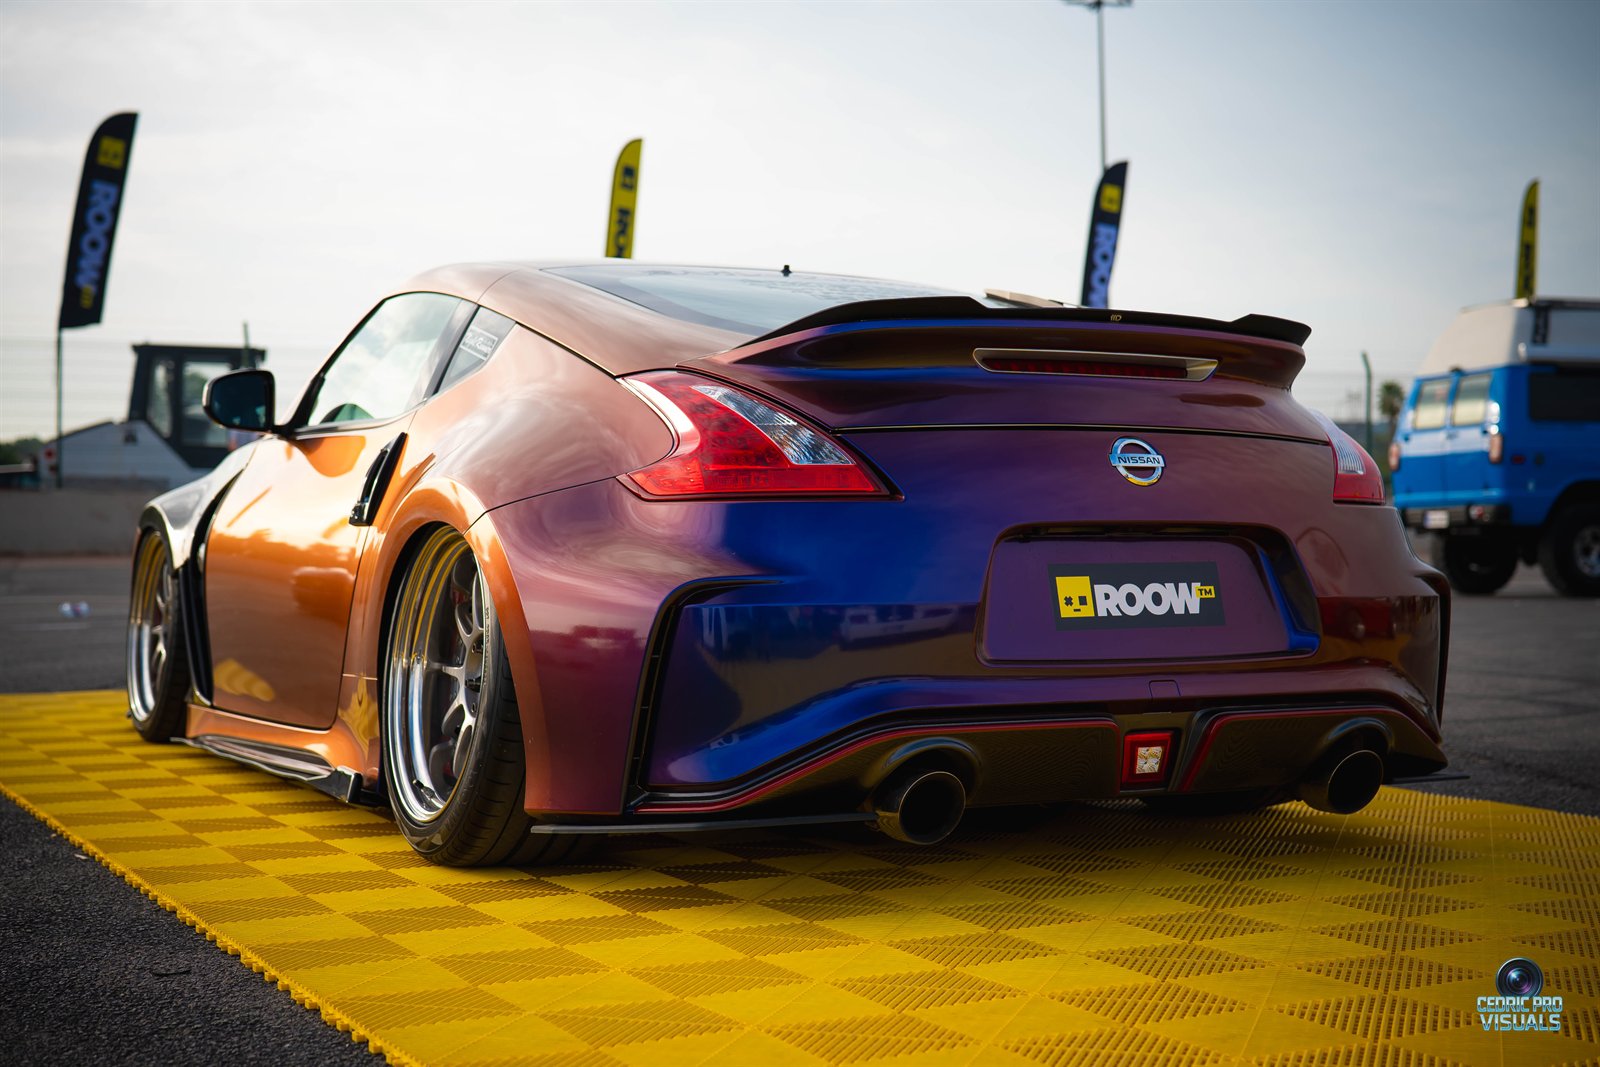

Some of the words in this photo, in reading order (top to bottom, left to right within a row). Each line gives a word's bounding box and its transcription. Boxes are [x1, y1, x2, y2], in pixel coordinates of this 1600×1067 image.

[74, 180, 118, 292] ROOW
[1117, 456, 1160, 465] NISSAN
[1094, 582, 1201, 617] ROOW
[1197, 587, 1213, 597] TM
